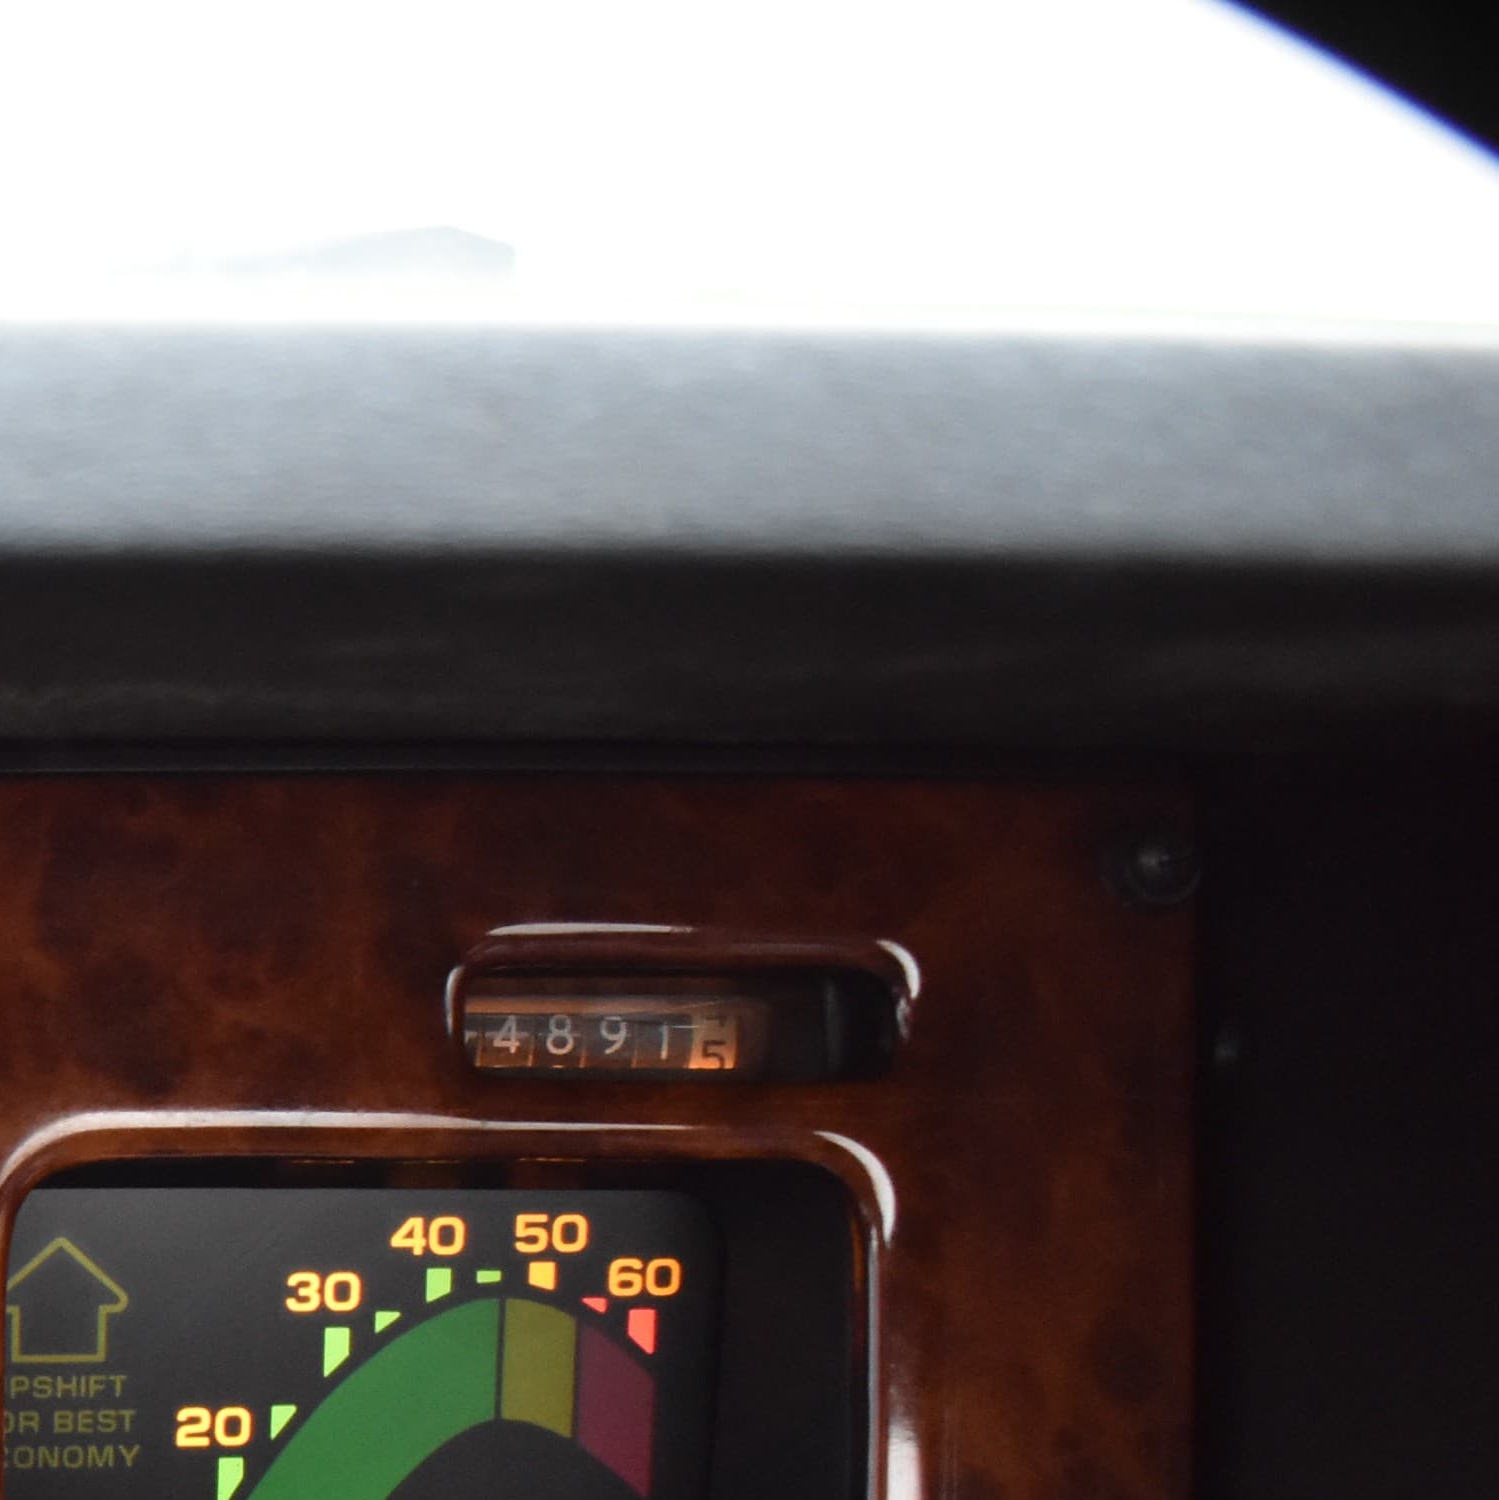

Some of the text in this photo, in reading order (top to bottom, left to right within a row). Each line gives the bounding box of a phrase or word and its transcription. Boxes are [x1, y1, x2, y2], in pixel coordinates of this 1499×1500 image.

[390, 1216, 467, 1256] 40
[514, 1214, 589, 1254] 50
[286, 1271, 362, 1313] 30
[608, 1258, 682, 1297] 60
[11, 1375, 127, 1399] PSHIFT
[4, 1409, 136, 1434] OR BEST
[175, 1406, 253, 1448] 20
[4, 1444, 140, 1469] ONOMY
